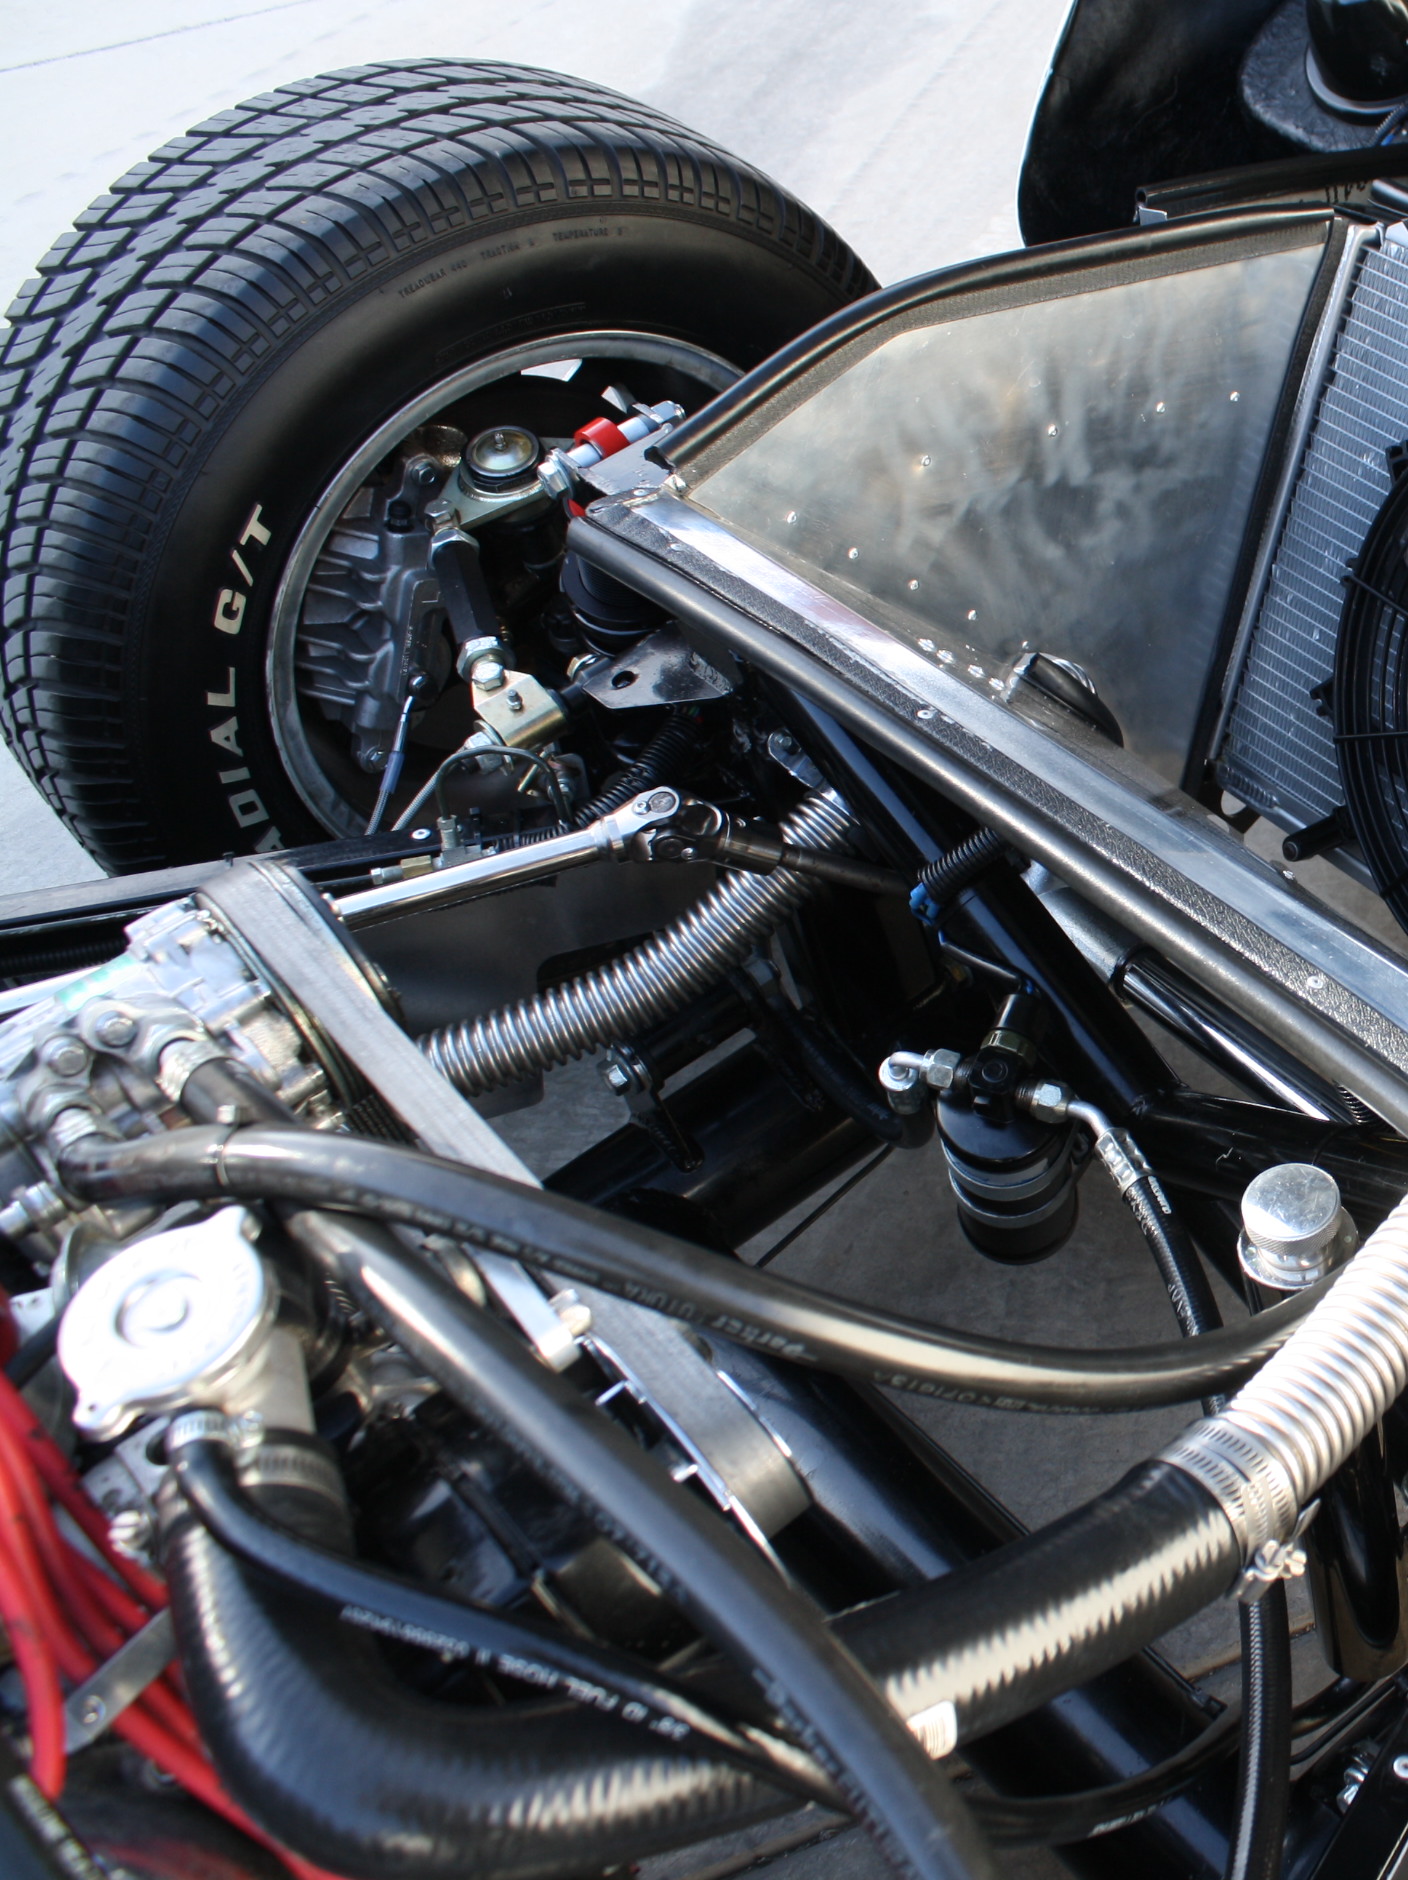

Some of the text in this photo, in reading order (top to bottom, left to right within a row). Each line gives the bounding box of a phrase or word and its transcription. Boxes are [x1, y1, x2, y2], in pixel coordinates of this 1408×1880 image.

[213, 503, 273, 635] G/T
[711, 1313, 810, 1361] Parker
[498, 1653, 560, 1690] HOSE
[563, 1675, 620, 1712] FUEL
